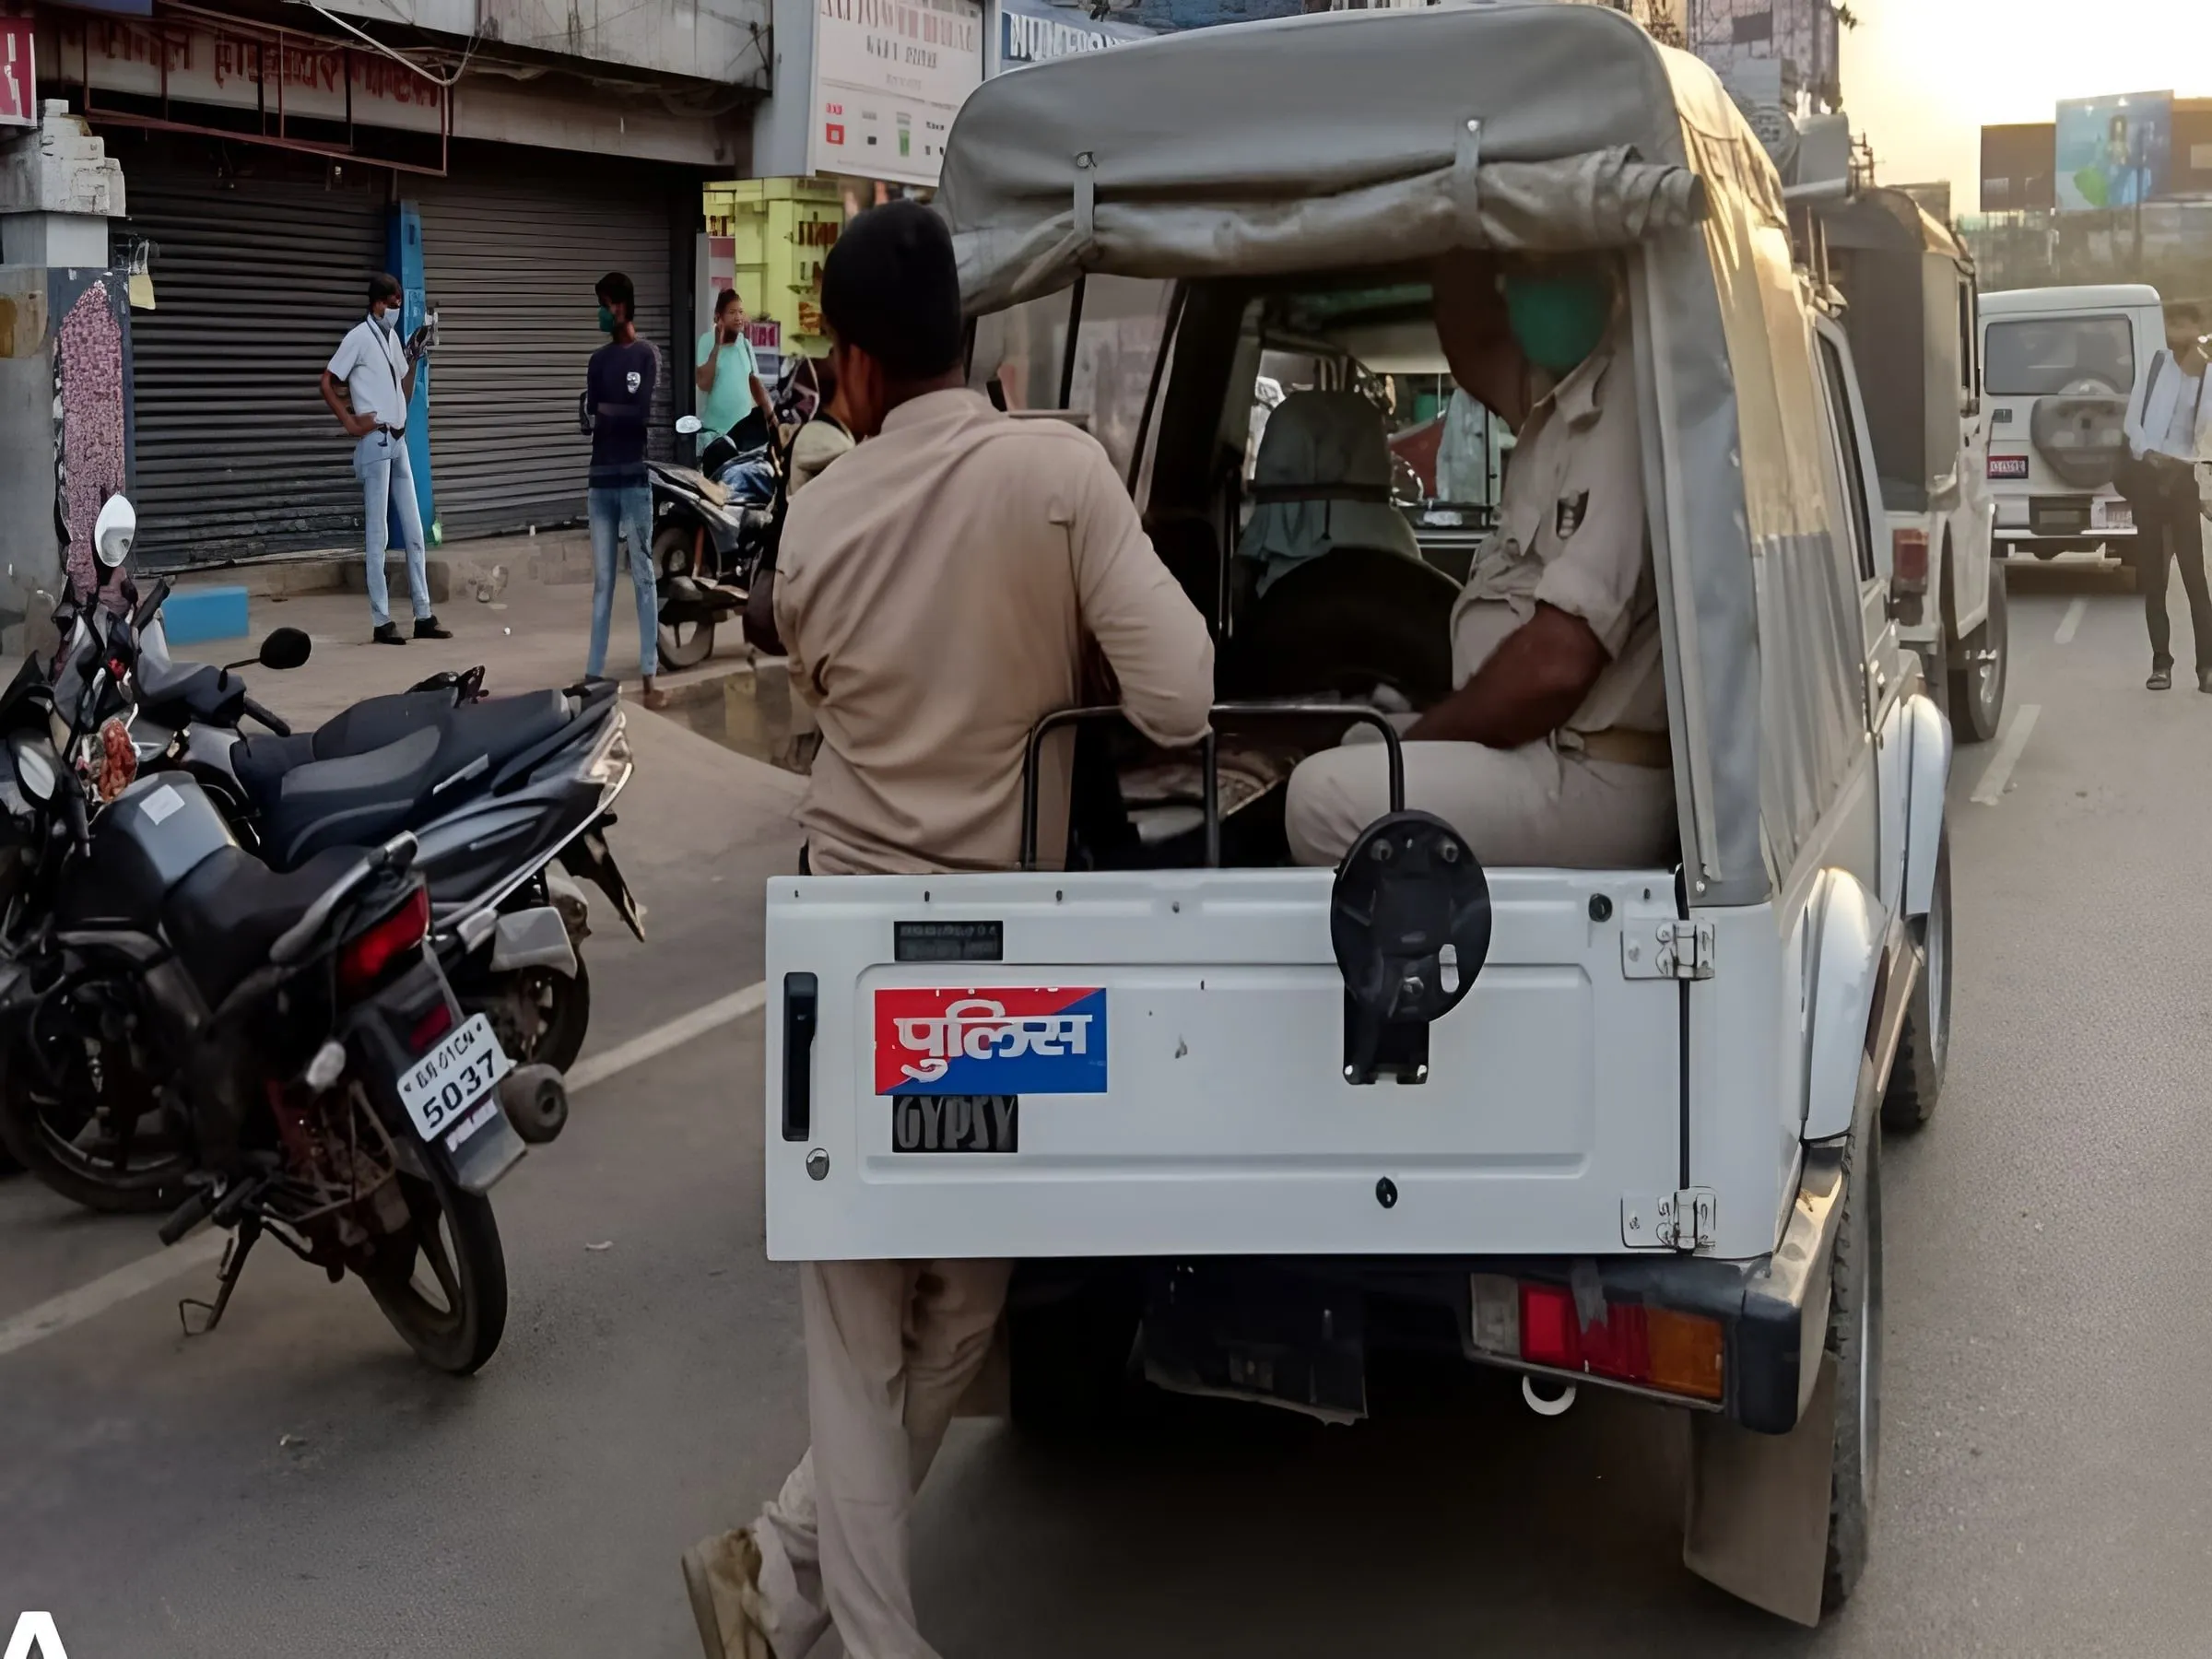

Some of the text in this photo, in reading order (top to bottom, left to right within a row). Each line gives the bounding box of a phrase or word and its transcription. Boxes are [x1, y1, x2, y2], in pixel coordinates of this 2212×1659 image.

[893, 999, 1093, 1083] पुलिस
[422, 1048, 494, 1129] 5037
[896, 1095, 1017, 1150] GYPSY
